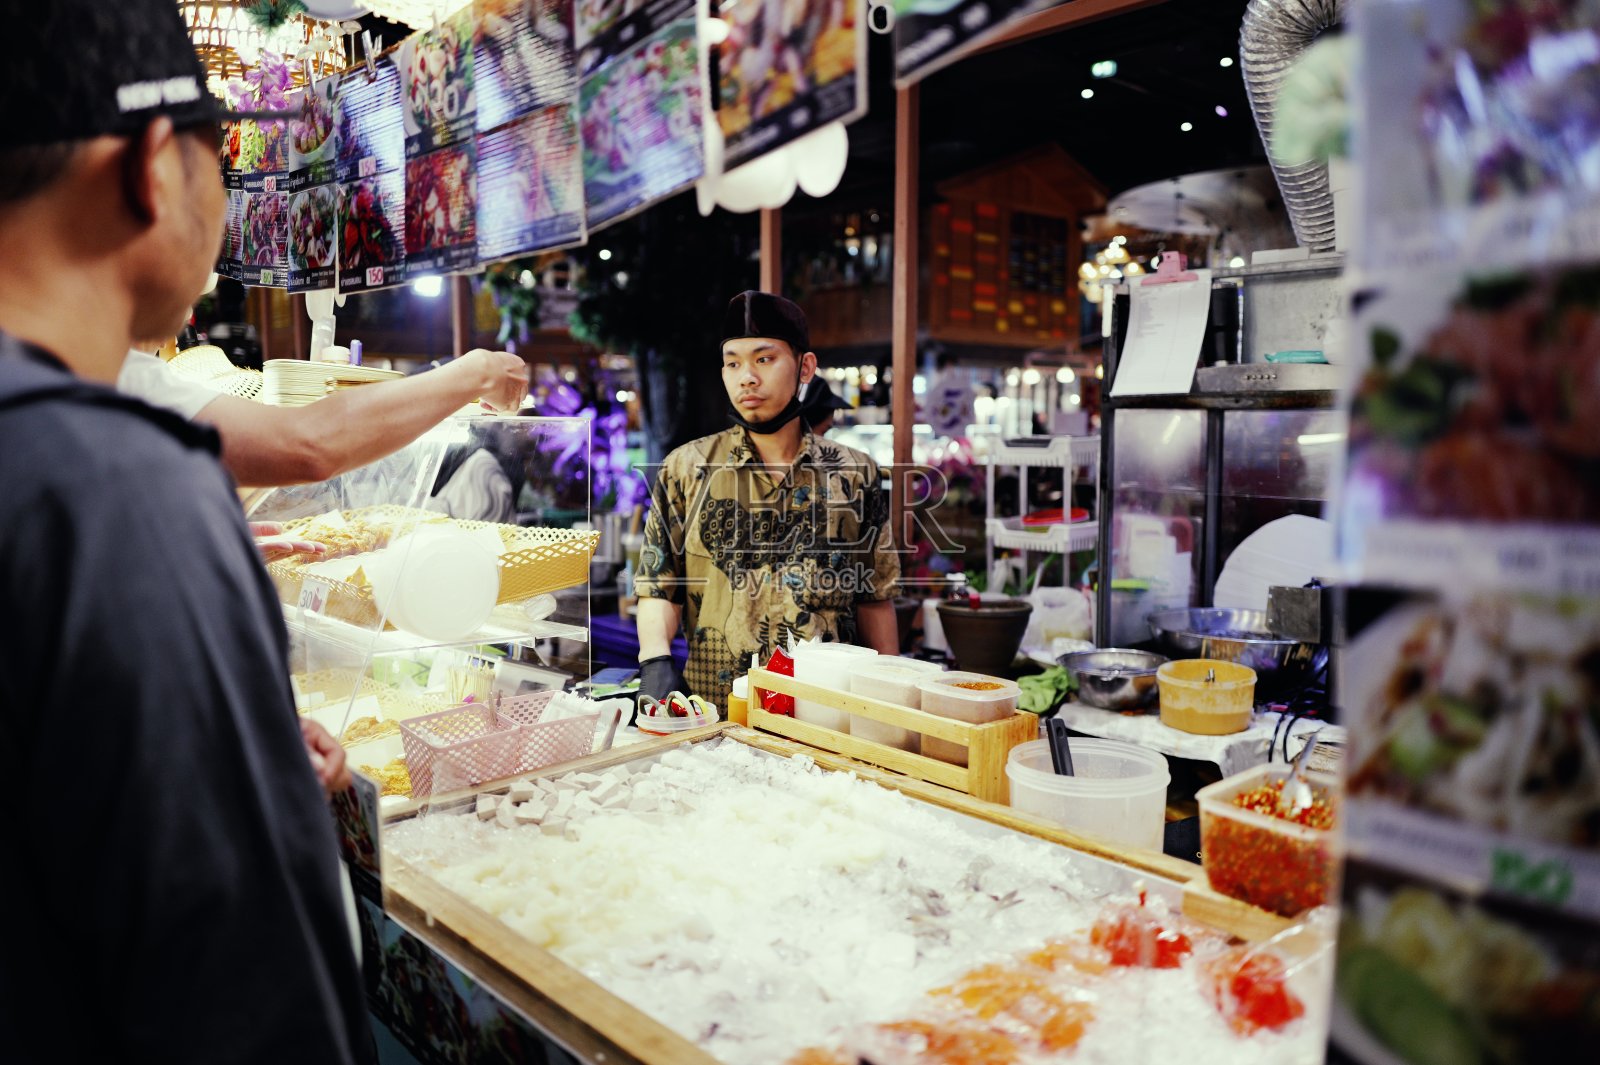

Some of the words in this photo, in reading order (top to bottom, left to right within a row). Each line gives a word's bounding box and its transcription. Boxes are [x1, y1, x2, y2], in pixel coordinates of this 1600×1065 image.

[266, 178, 276, 191] 80
[368, 268, 383, 284] 150
[300, 589, 313, 609] 30
